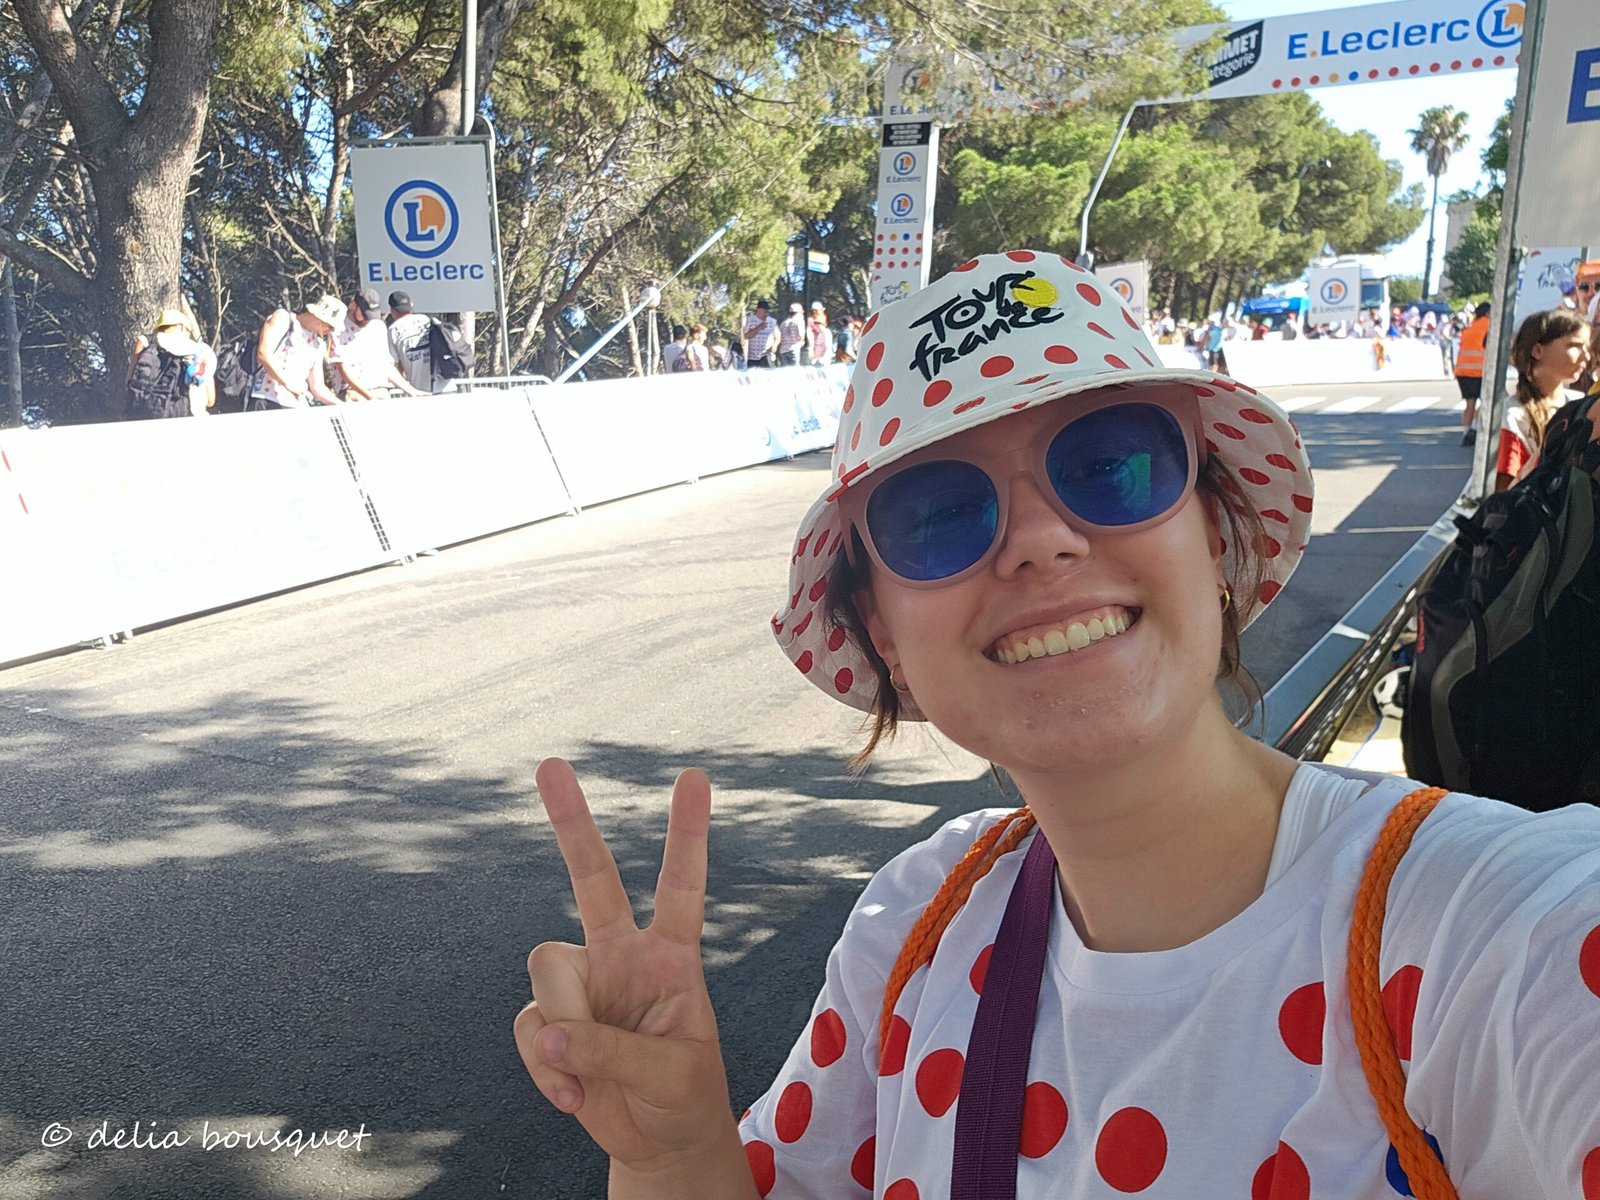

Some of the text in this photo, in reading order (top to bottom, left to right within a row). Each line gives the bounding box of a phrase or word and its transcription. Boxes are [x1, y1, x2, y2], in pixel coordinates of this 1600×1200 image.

[1287, 18, 1470, 60] E.Leclerc
[886, 176, 922, 184] E.Leclerc
[883, 217, 919, 225] E.Leclerc
[368, 261, 484, 282] E.Leclerc
